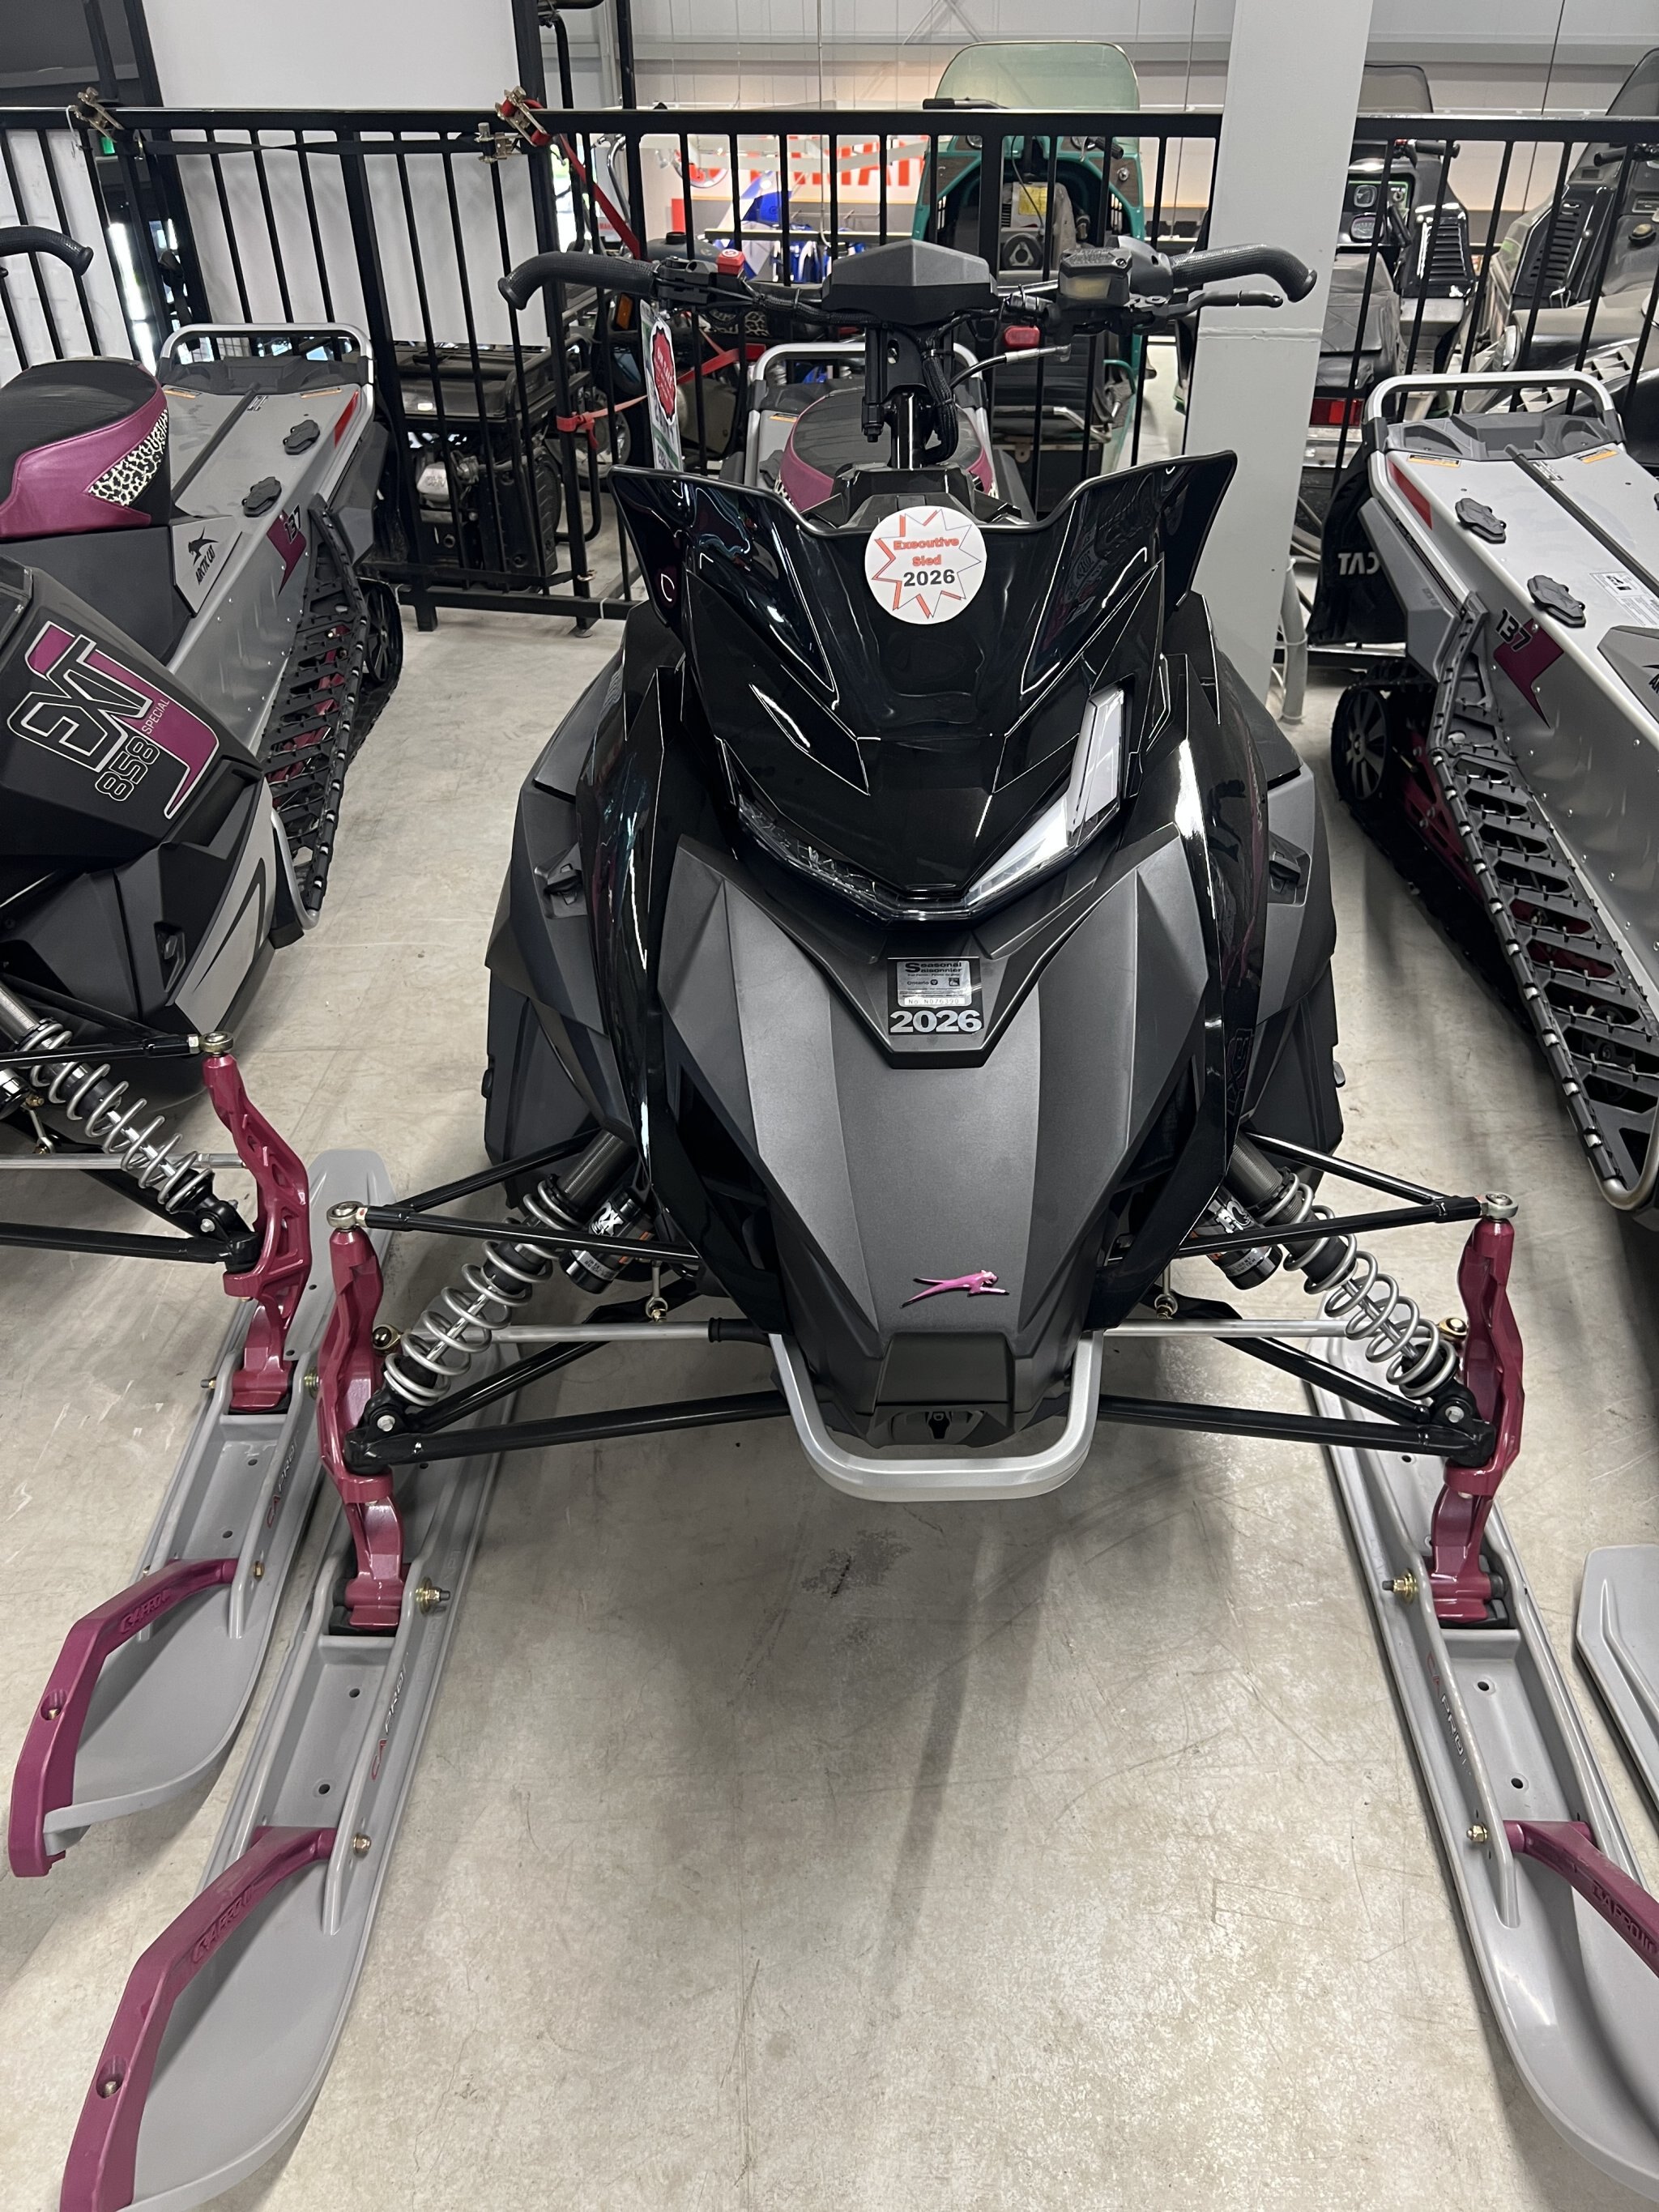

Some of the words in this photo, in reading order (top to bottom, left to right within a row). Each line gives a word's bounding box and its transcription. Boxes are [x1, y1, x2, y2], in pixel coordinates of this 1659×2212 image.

[893, 536, 960, 551] Executive
[912, 554, 941, 567] Sled
[903, 569, 955, 587] 2026
[1495, 607, 1533, 653] 137
[141, 698, 170, 735] SPECIAL
[95, 735, 160, 802] 858
[889, 1009, 983, 1033] 2026
